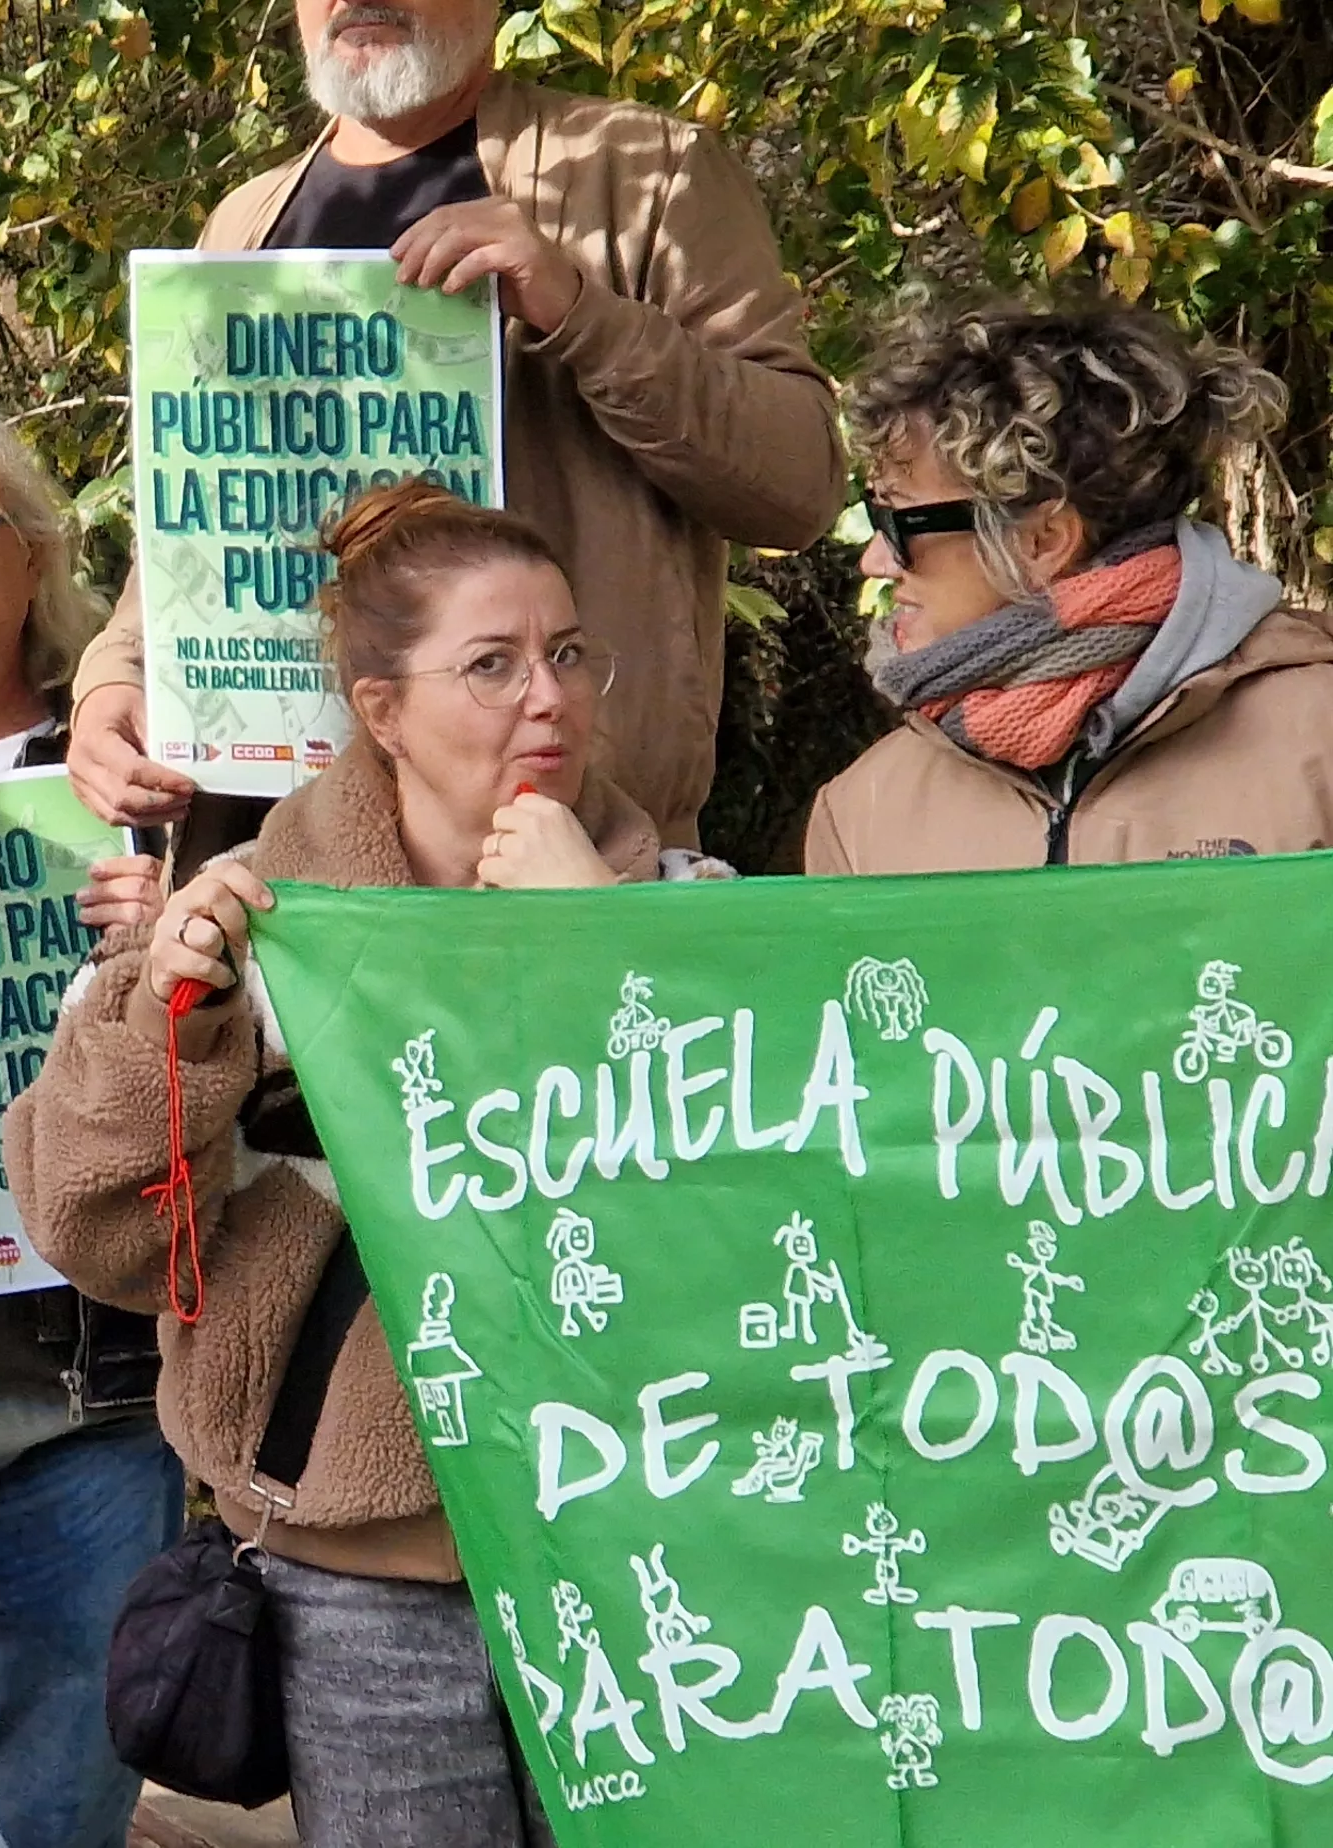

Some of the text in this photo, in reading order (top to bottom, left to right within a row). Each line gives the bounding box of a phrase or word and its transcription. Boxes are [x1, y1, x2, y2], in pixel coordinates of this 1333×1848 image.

[225, 311, 402, 379] DINERO
[151, 374, 483, 456] PÚBLICO PARA
[153, 467, 212, 533] LA
[176, 636, 200, 660] NO
[204, 637, 215, 660] A
[217, 636, 250, 661] LOS
[185, 665, 207, 689] EN
[1196, 838, 1230, 849] THE
[406, 999, 870, 1221] ESCUELA
[531, 1348, 1329, 1522] DE TOD@S
[518, 1606, 1333, 1786] PARA TOD@
